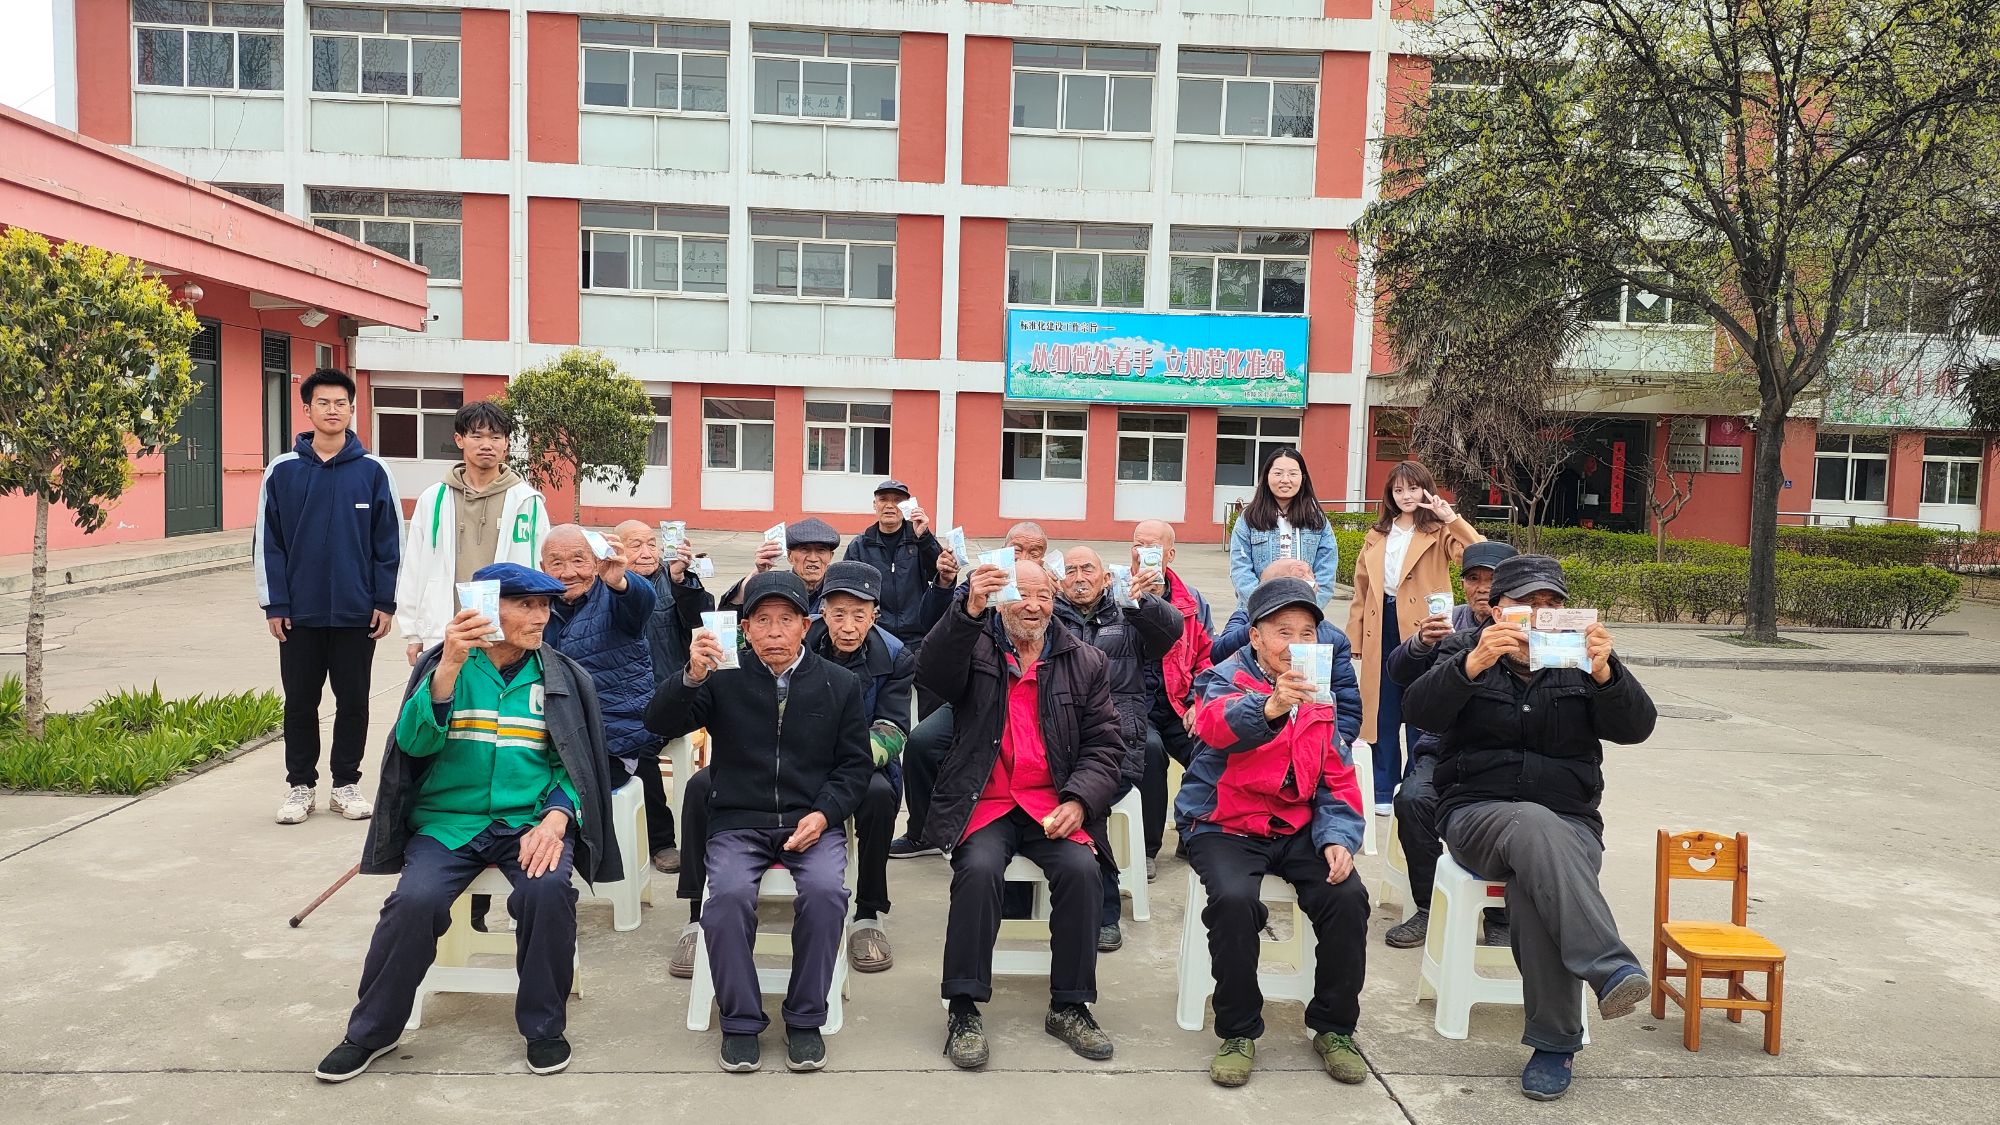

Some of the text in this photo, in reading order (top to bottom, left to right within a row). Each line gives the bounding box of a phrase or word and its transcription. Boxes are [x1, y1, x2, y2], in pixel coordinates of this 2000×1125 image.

[1029, 342, 1286, 380] 从细微处着手 立规范化准绳
